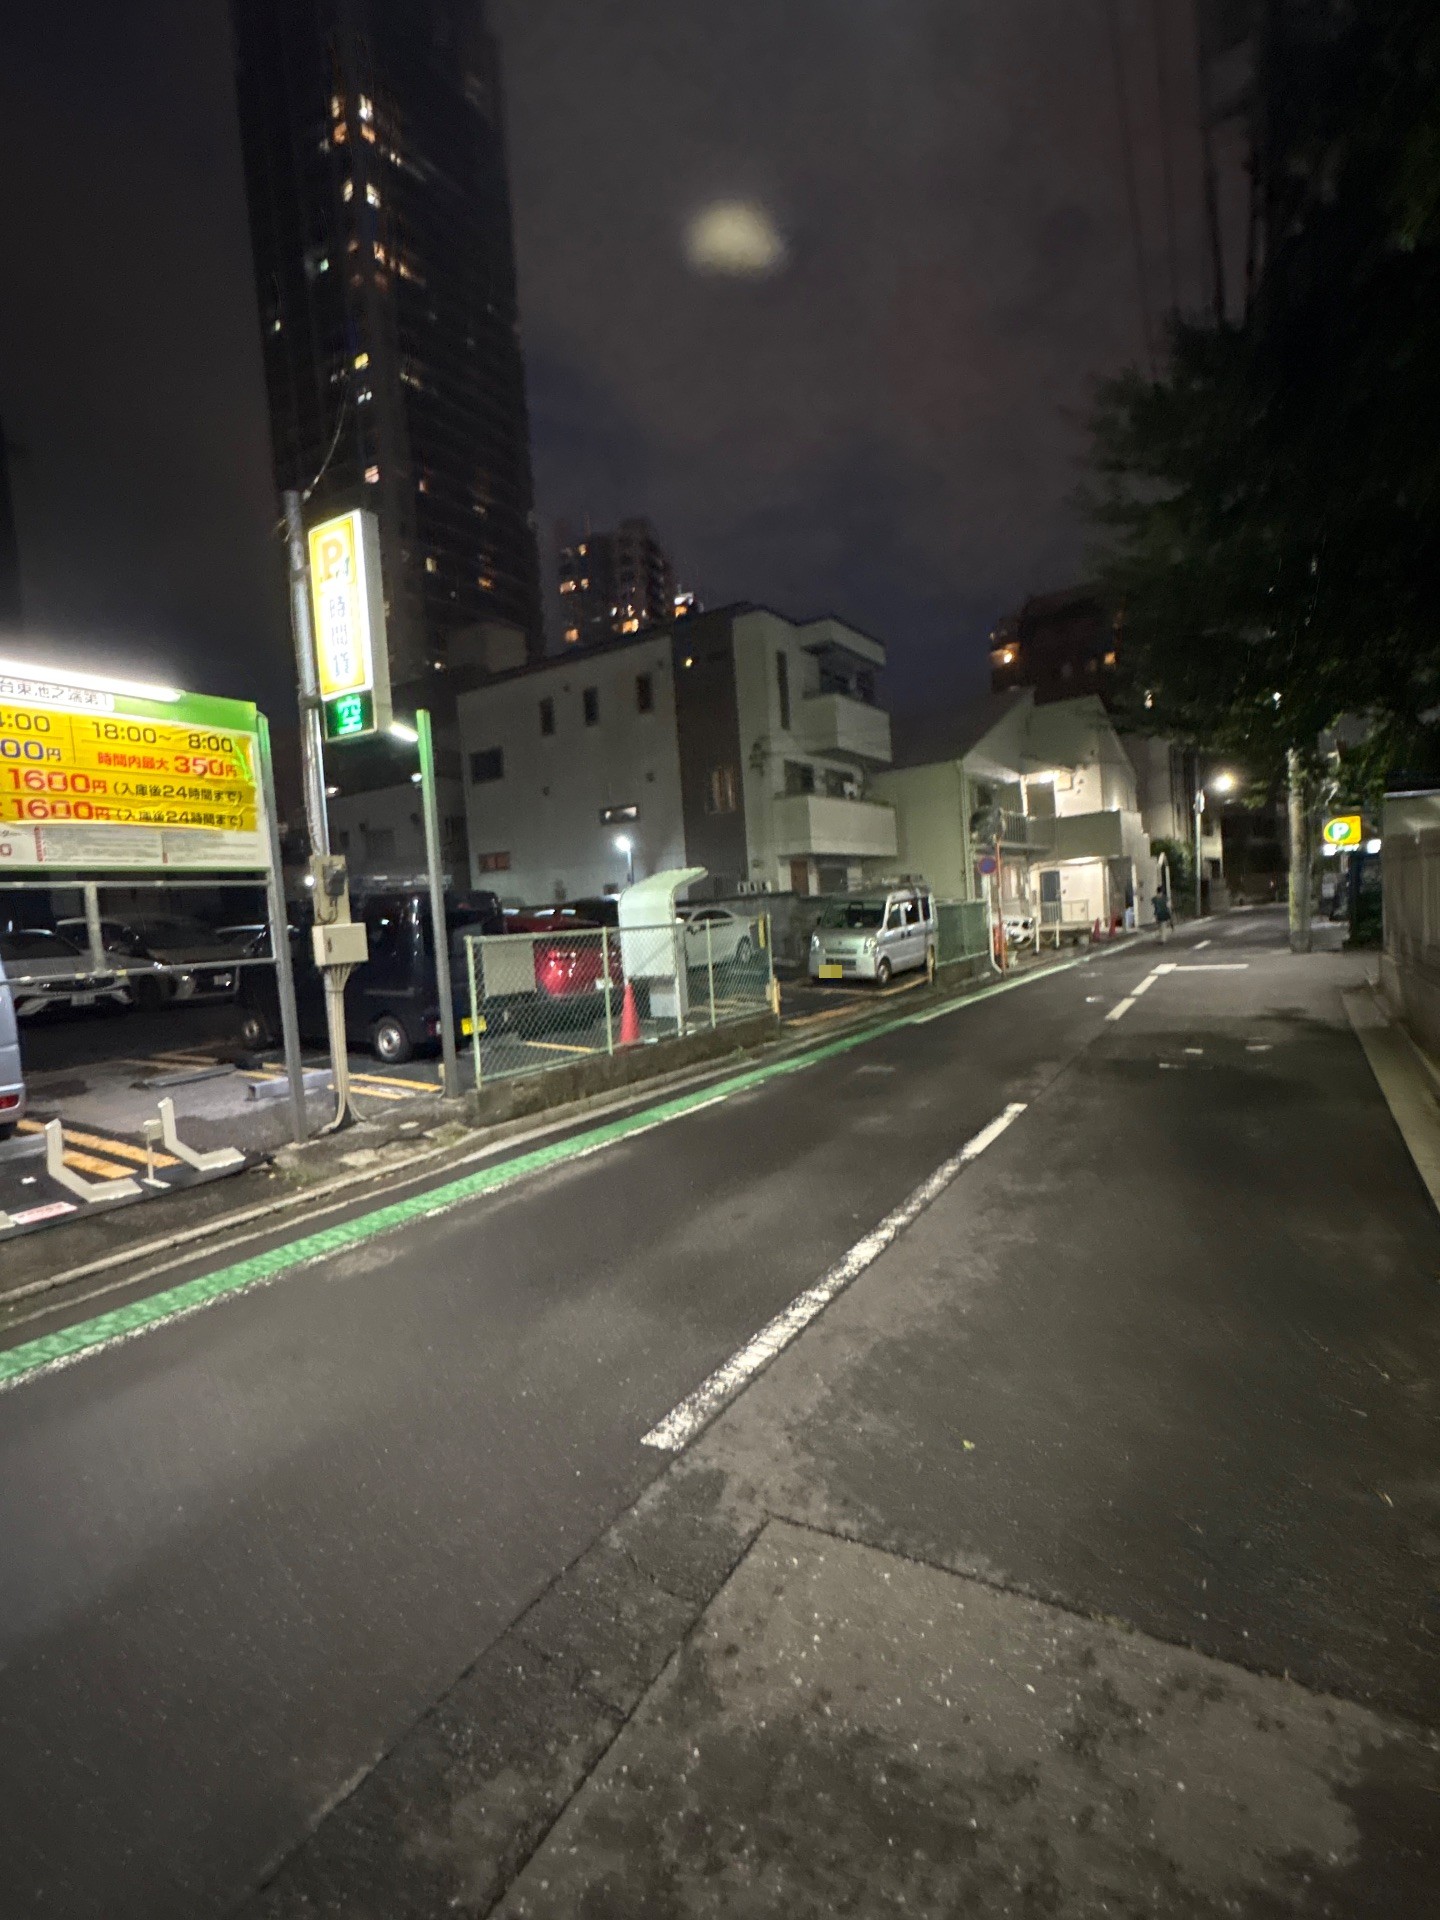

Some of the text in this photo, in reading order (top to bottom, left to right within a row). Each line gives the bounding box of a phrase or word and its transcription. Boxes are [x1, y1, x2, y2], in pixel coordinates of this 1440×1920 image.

[337, 694, 362, 735] 空
[188, 733, 233, 753] 8:00
[97, 751, 237, 778] 時間内最大 350円
[8, 768, 107, 793] 1600円
[12, 798, 110, 820] 1600円
[1332, 822, 1349, 840] P
